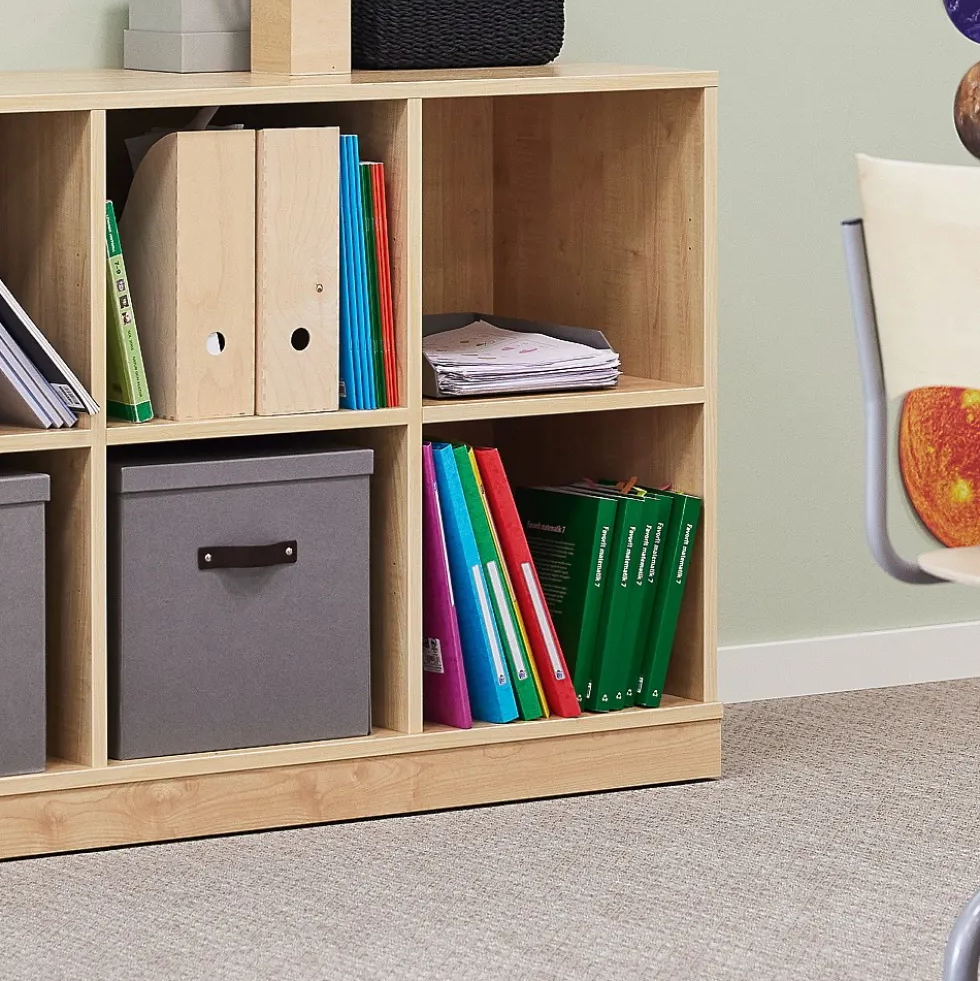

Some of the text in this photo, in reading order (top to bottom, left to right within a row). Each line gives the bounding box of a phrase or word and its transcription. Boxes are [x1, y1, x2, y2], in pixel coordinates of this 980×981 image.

[600, 526, 610, 548] Favorit
[627, 526, 636, 548] Favorit
[643, 524, 653, 546] Favorit
[655, 522, 664, 544] Favorit
[683, 523, 693, 545] Favorit
[594, 548, 605, 582] matematik
[621, 548, 632, 582] matematik
[637, 546, 647, 580] matematik
[648, 544, 659, 577] matematik
[676, 545, 687, 578] matematik
